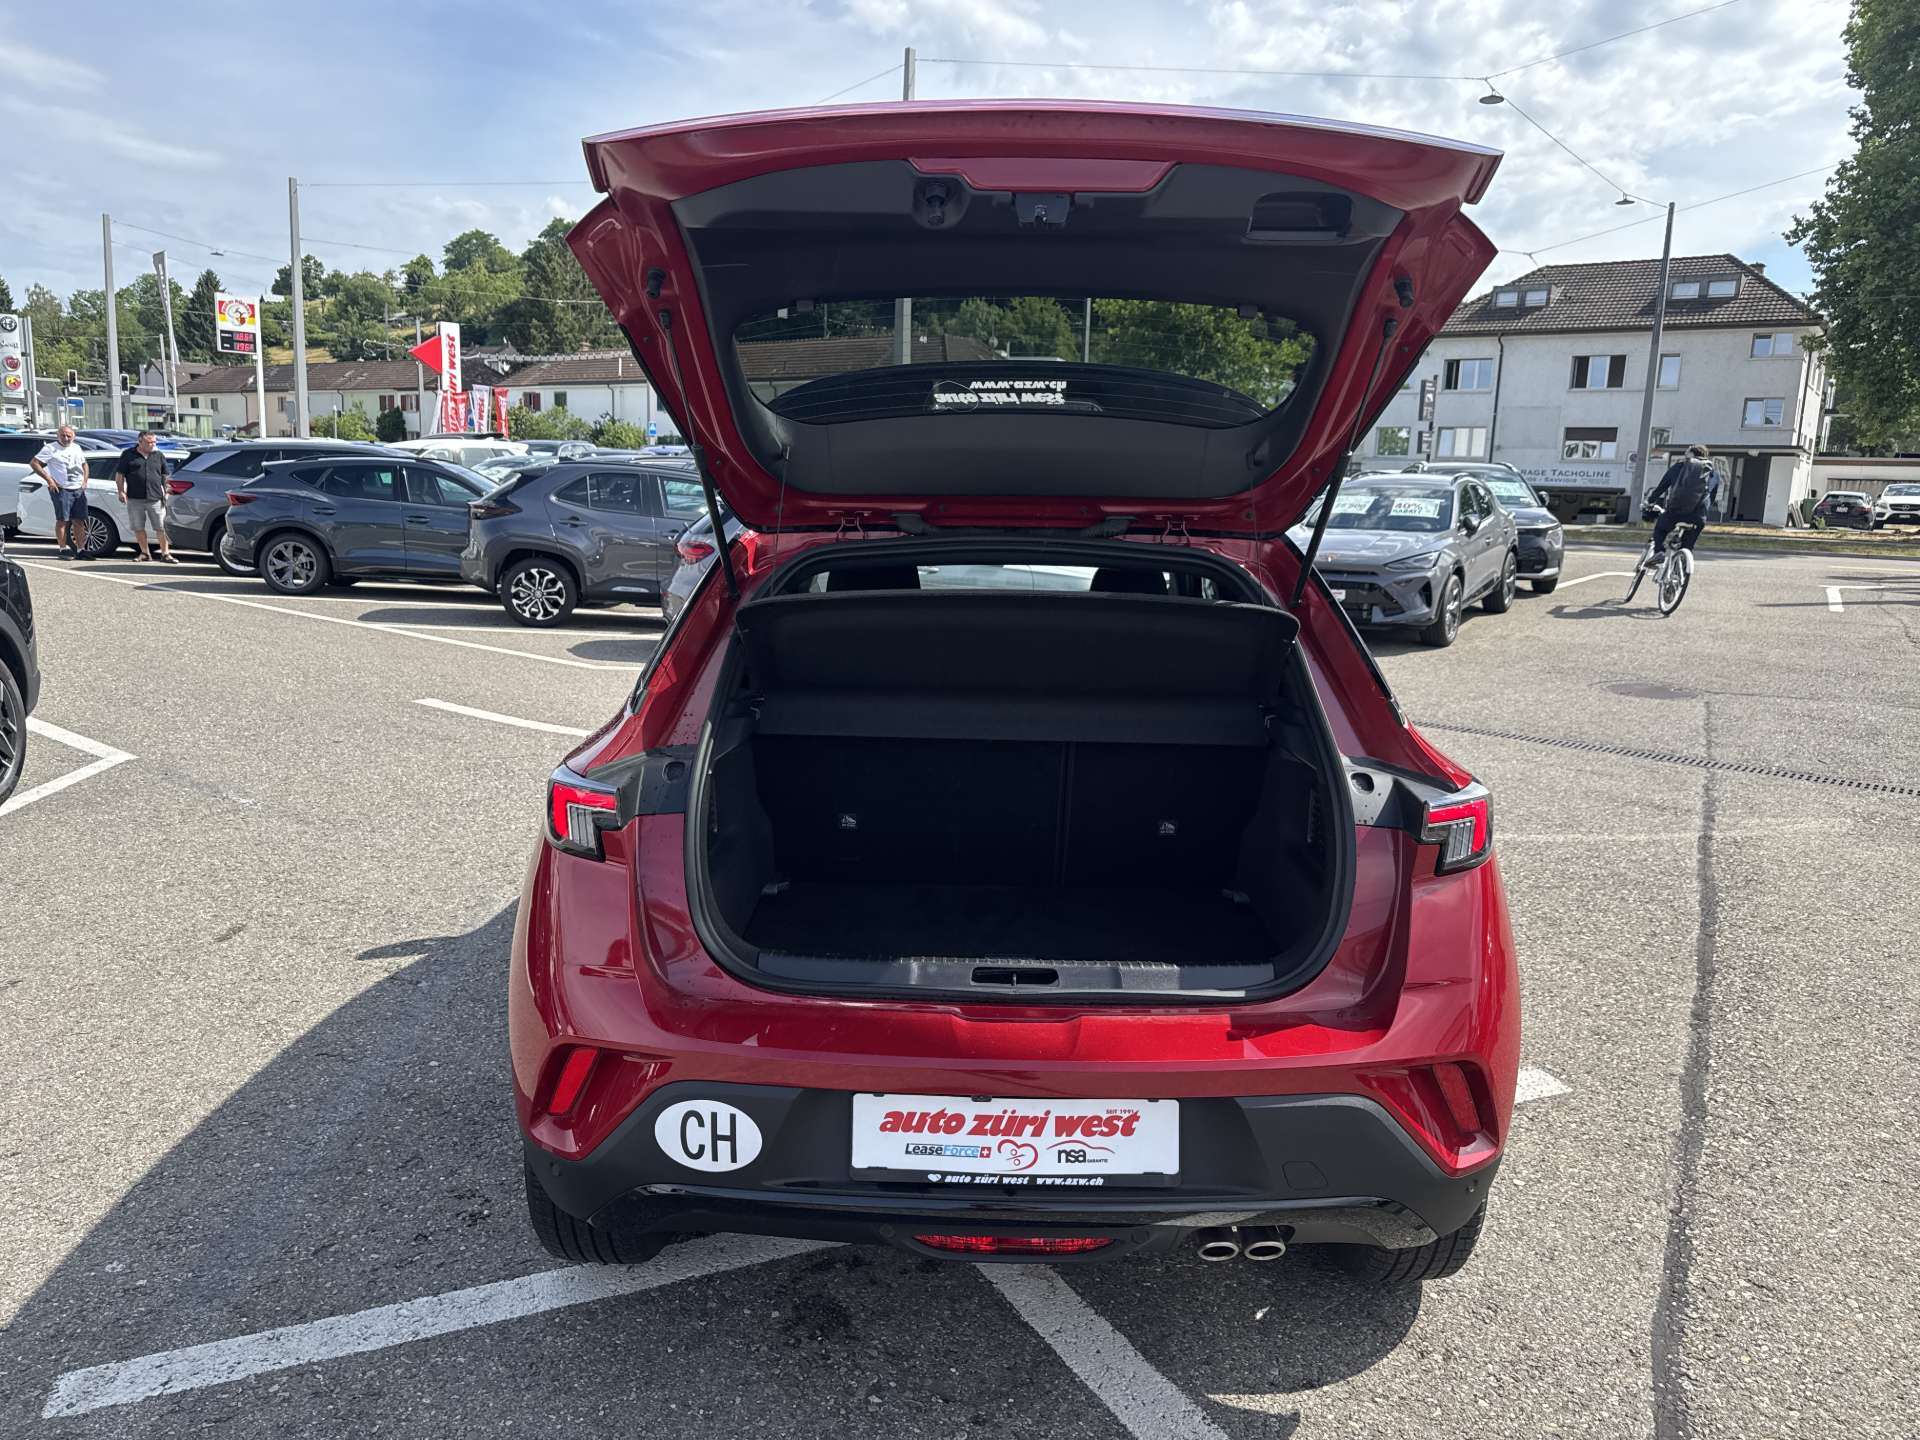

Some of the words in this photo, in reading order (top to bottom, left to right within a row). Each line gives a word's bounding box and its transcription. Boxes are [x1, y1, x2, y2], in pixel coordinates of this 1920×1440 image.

[447, 333, 456, 370] west
[879, 1107, 966, 1135] auto
[967, 1109, 1051, 1137] züri
[1054, 1110, 1141, 1138] west
[680, 1109, 738, 1164] CH
[905, 1143, 979, 1159] LeaseForce
[1057, 1149, 1087, 1164] nsa
[944, 1175, 972, 1183] auto
[974, 1174, 999, 1184] züri
[1002, 1175, 1029, 1184] west
[1036, 1176, 1104, 1186] www.azw.ch
